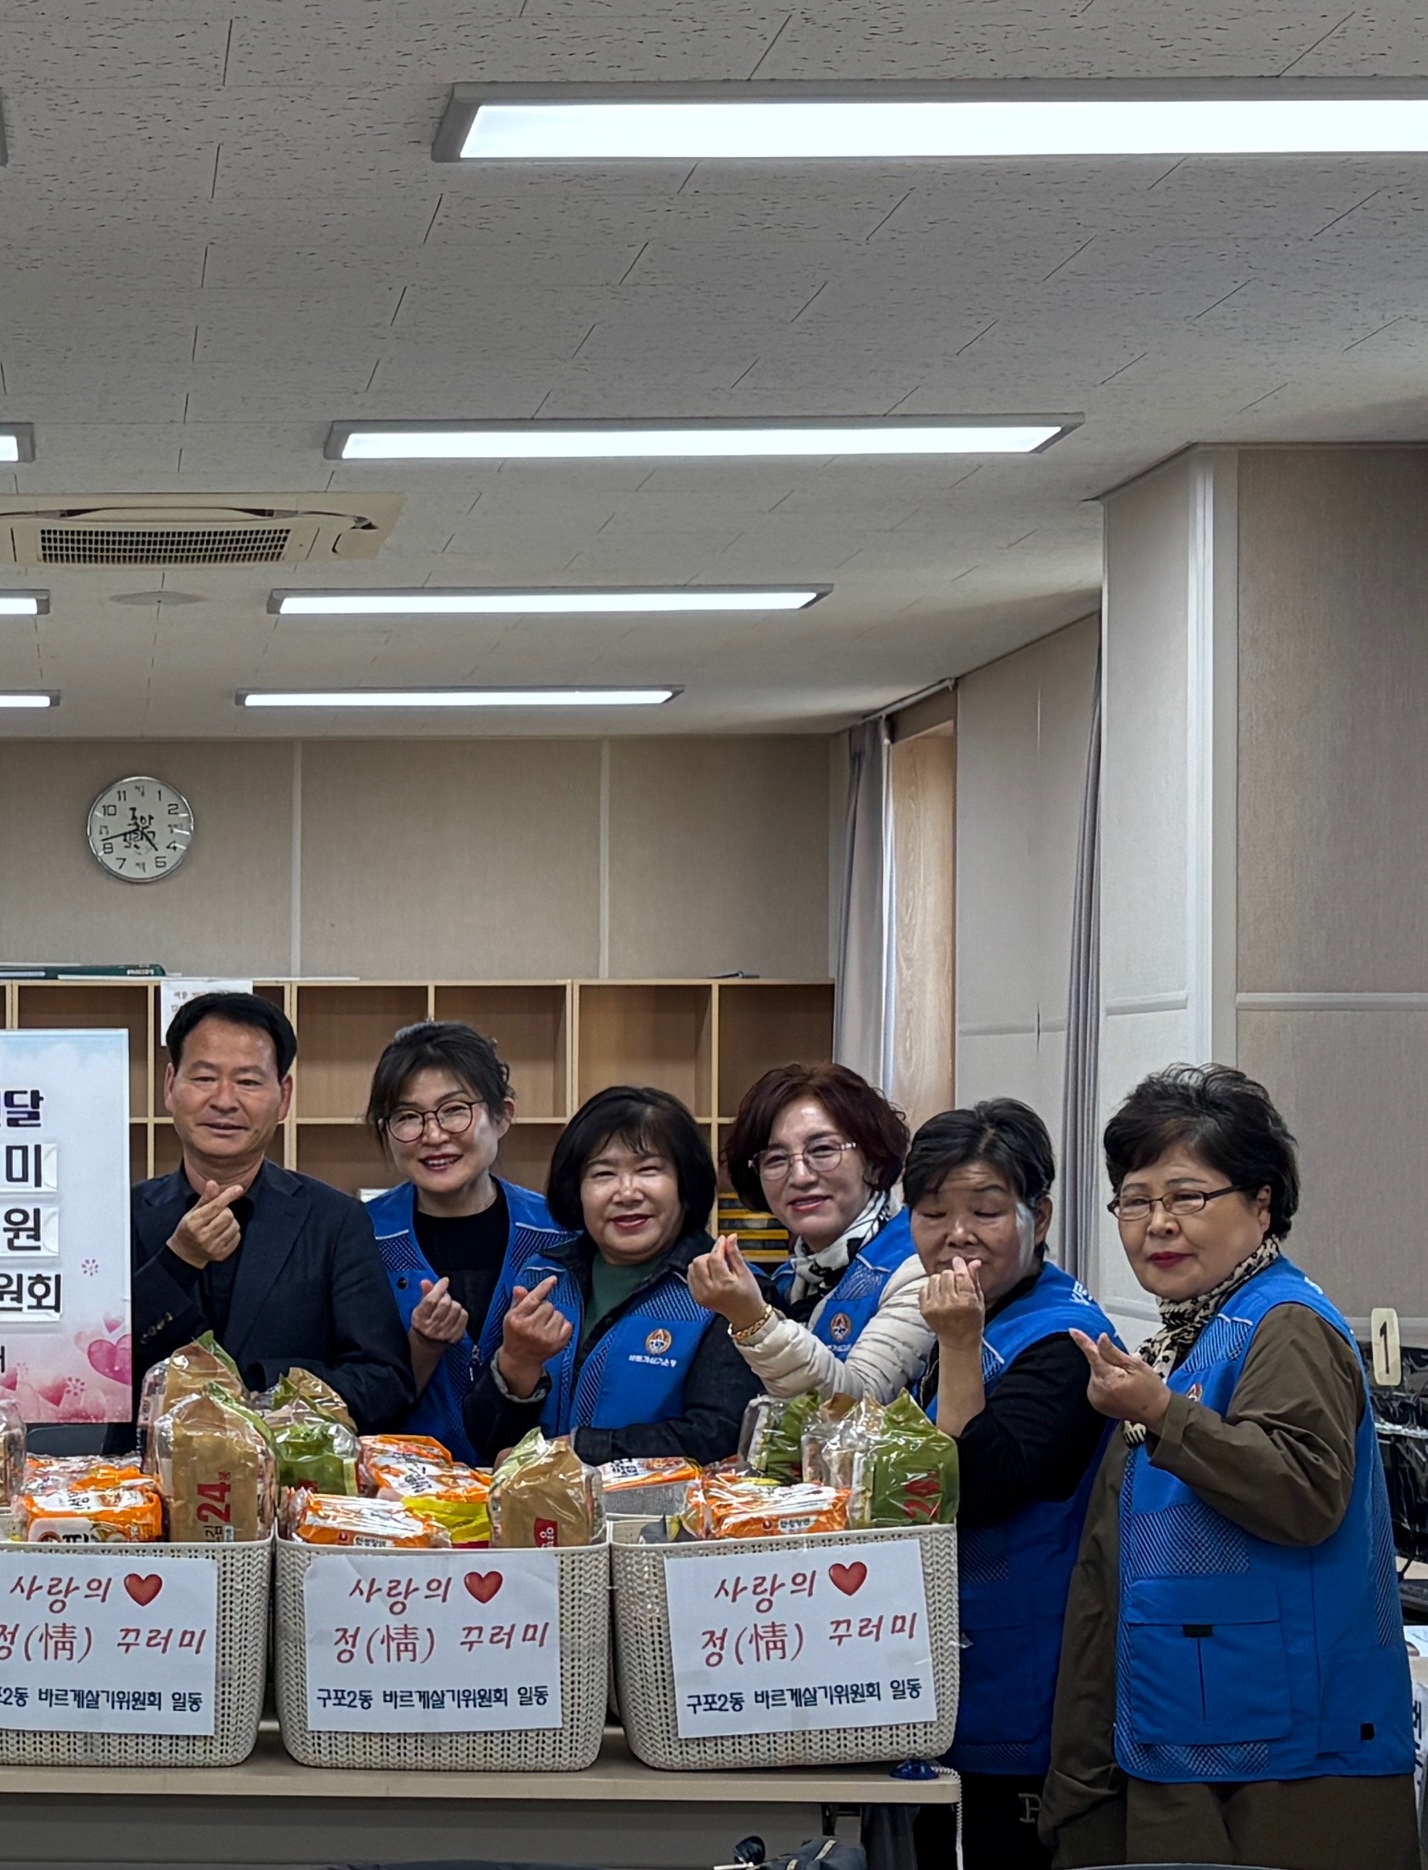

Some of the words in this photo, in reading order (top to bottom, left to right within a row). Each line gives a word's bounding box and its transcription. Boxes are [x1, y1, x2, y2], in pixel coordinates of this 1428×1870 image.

[102, 804, 117, 816] 10
[168, 803, 179, 815] 2
[102, 842, 114, 854] 8
[116, 857, 127, 869] 7
[1380, 1321, 1391, 1375] 1
[10, 1575, 112, 1614] 사랑의
[349, 1577, 452, 1615] 사랑의
[714, 1570, 816, 1613] 사랑의
[117, 1628, 206, 1654] 꾸러미
[334, 1624, 434, 1664] 정(情)
[460, 1622, 549, 1652] 꾸러미
[702, 1621, 803, 1667] 정(情)
[829, 1612, 917, 1646] 꾸러미
[39, 1688, 161, 1711] 바르게살기위원회
[171, 1692, 202, 1712] 일동
[317, 1689, 373, 1710] 구포2동
[383, 1688, 507, 1709] 바르게살기위원회
[517, 1686, 549, 1706] 일동
[687, 1692, 745, 1714] 구포2동
[754, 1682, 881, 1710] 바르게살기위원회
[890, 1678, 922, 1700] 일동
